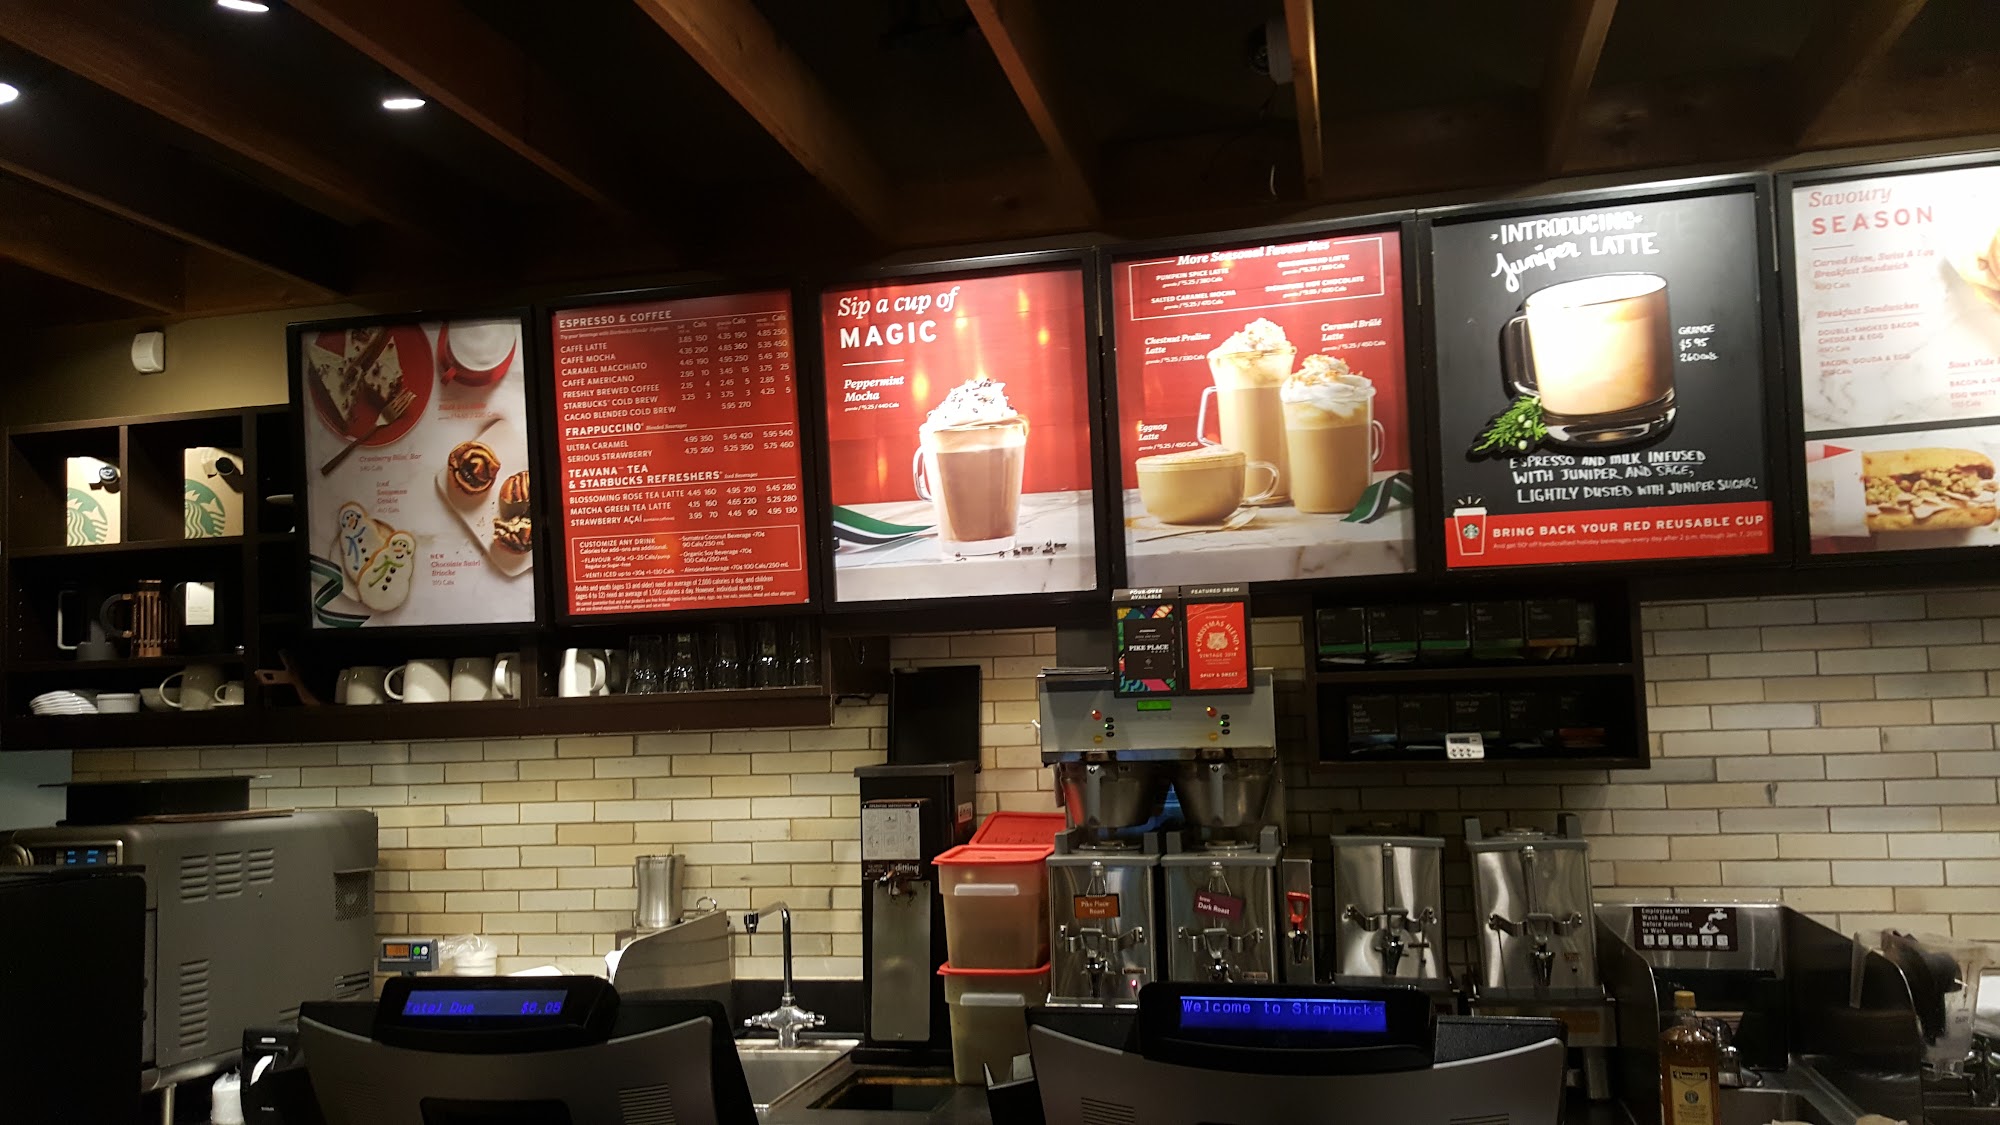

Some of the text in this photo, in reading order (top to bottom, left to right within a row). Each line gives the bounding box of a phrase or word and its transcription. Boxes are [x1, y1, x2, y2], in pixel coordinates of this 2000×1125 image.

[1809, 188, 1892, 208] Savoury
[1812, 206, 1932, 235] SEASON
[1501, 211, 1635, 245] INTRODUCING
[1176, 254, 1209, 266] More
[1491, 232, 1660, 292] Juniper LATTE
[838, 286, 960, 319] Sip a cup of
[560, 310, 672, 328] ESPRESSO & COFFEE
[1321, 321, 1357, 331] Caramel
[841, 320, 937, 348] MAGIC
[1145, 332, 1211, 345] Chestnut Praline
[1321, 333, 1344, 341] Latte
[585, 342, 607, 351] LATTE
[586, 354, 616, 362] MOCHA
[561, 362, 647, 376] CARAMEL MACCHIATO
[587, 375, 634, 385] AMERICANO
[844, 376, 904, 390] Peppermint
[563, 390, 594, 398] FRESHLY
[597, 387, 629, 395] BREWED
[631, 384, 659, 392] COFFEE
[844, 391, 880, 402] Mocha
[564, 396, 658, 410] STARBUCKS COLD BREW
[564, 413, 591, 421] CACAO
[594, 409, 627, 418] BLENDED
[630, 408, 651, 416] COLD
[653, 406, 676, 414] BREW
[565, 423, 641, 436] FRAPPUCCINO
[1138, 424, 1168, 432] Eggnog
[566, 440, 629, 451] ULTRA CARAMEL
[567, 450, 652, 463] SERIOUS STRAWBERRY
[1581, 456, 1606, 466] AND
[1648, 450, 1706, 463] INFUSED
[568, 465, 648, 478] TEAVANA TEA
[1512, 465, 1694, 484] WITH JUNIPER AND SAGE,
[568, 471, 720, 489] & STARBUCKS REFRESHERS
[570, 490, 684, 504] BLOSSOMING ROSE TEA LATTE
[1517, 478, 1758, 503] LIGHTLY DUSTED WITH JUNIPER SUGAR!
[570, 506, 602, 515] MATCHA
[605, 505, 630, 513] GREEN
[649, 502, 671, 510] LATTE
[571, 517, 621, 527] STRAWBERRY
[624, 514, 643, 524] AÇAÍ
[1493, 515, 1764, 538] BRING BACK YOUR RED REUSABLE CUP
[580, 540, 617, 548] CUSTOMIZE
[1196, 620, 1224, 647] CHRISTMAS
[1198, 902, 1230, 915] Dark Roast
[405, 1002, 442, 1013] Total
[450, 1002, 474, 1013] Due
[1182, 1000, 1384, 1016] Welcome to Starbucks
